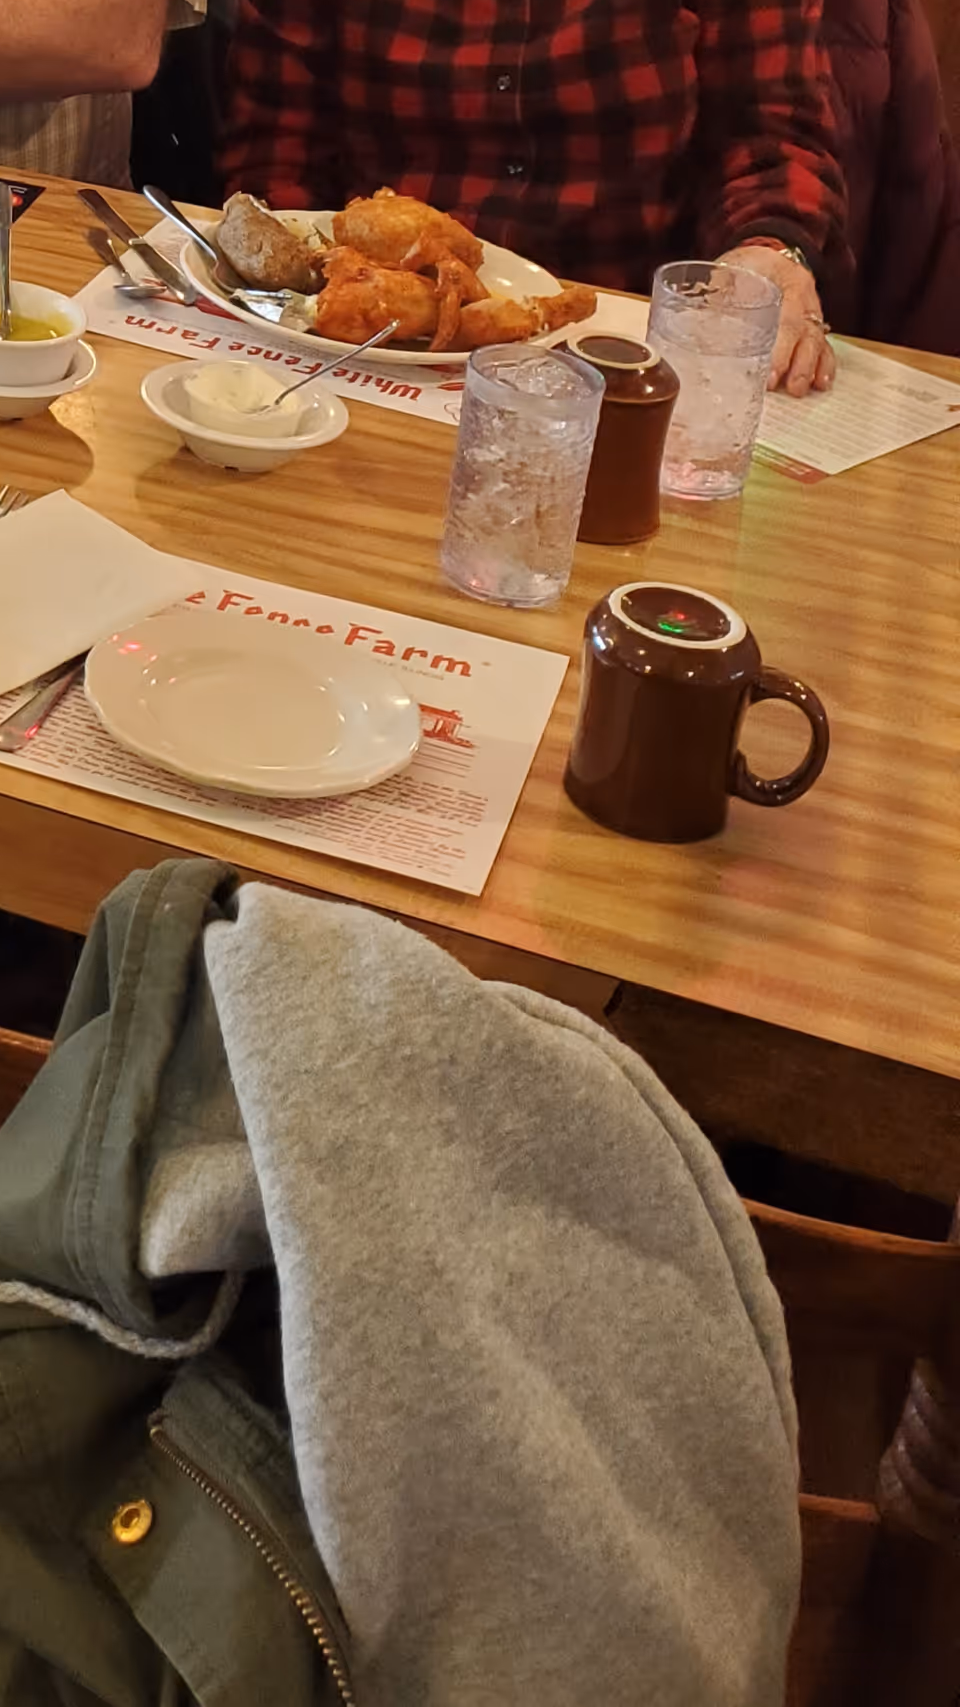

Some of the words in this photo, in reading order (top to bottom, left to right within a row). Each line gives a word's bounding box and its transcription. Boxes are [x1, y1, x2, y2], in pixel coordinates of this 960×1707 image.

[124, 314, 221, 351] Farm
[227, 342, 323, 376] Fence
[331, 365, 423, 402] White
[344, 622, 472, 678] Farm
